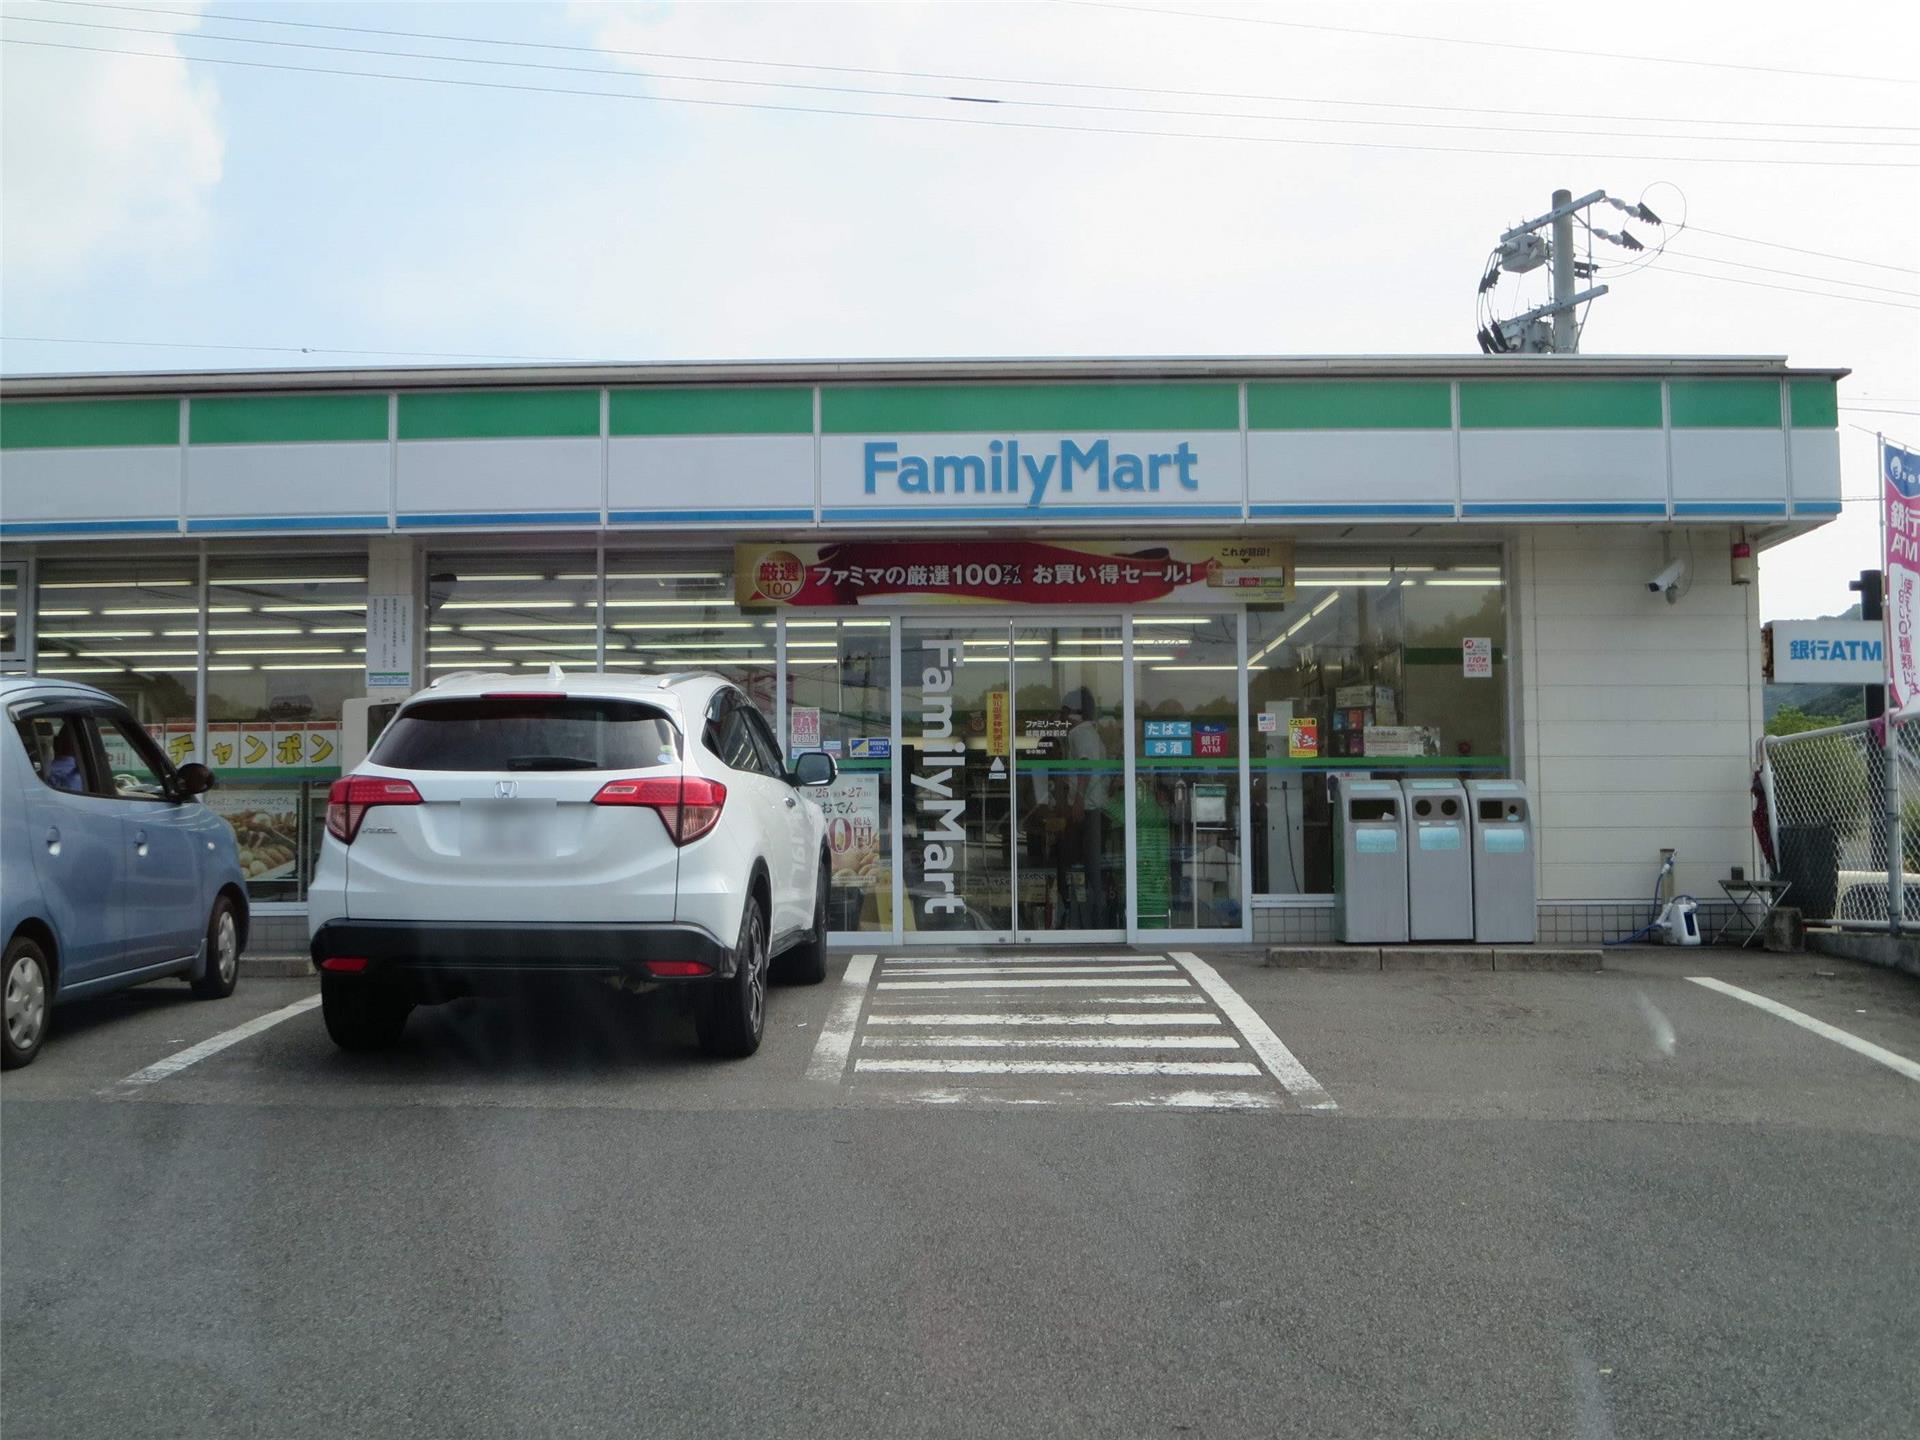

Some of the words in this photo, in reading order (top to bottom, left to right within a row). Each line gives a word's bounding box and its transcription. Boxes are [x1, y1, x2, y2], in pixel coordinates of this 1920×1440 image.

[864, 439, 1198, 508] FamilyMart
[1890, 502, 1920, 538] 銀行
[1891, 535, 1918, 563] ATM
[760, 563, 798, 581] 厳選
[765, 582, 792, 595] 100
[1790, 640, 1882, 660] 銀行ATM
[1025, 720, 1072, 728] ファミリーマート
[1147, 723, 1189, 735] たばこ
[169, 733, 334, 765] チャンポン
[1155, 742, 1183, 754] お酒
[1201, 735, 1221, 745] 銀行
[910, 639, 967, 914] FamilyMart
[821, 802, 858, 814] おでん
[826, 818, 873, 853] 0円
